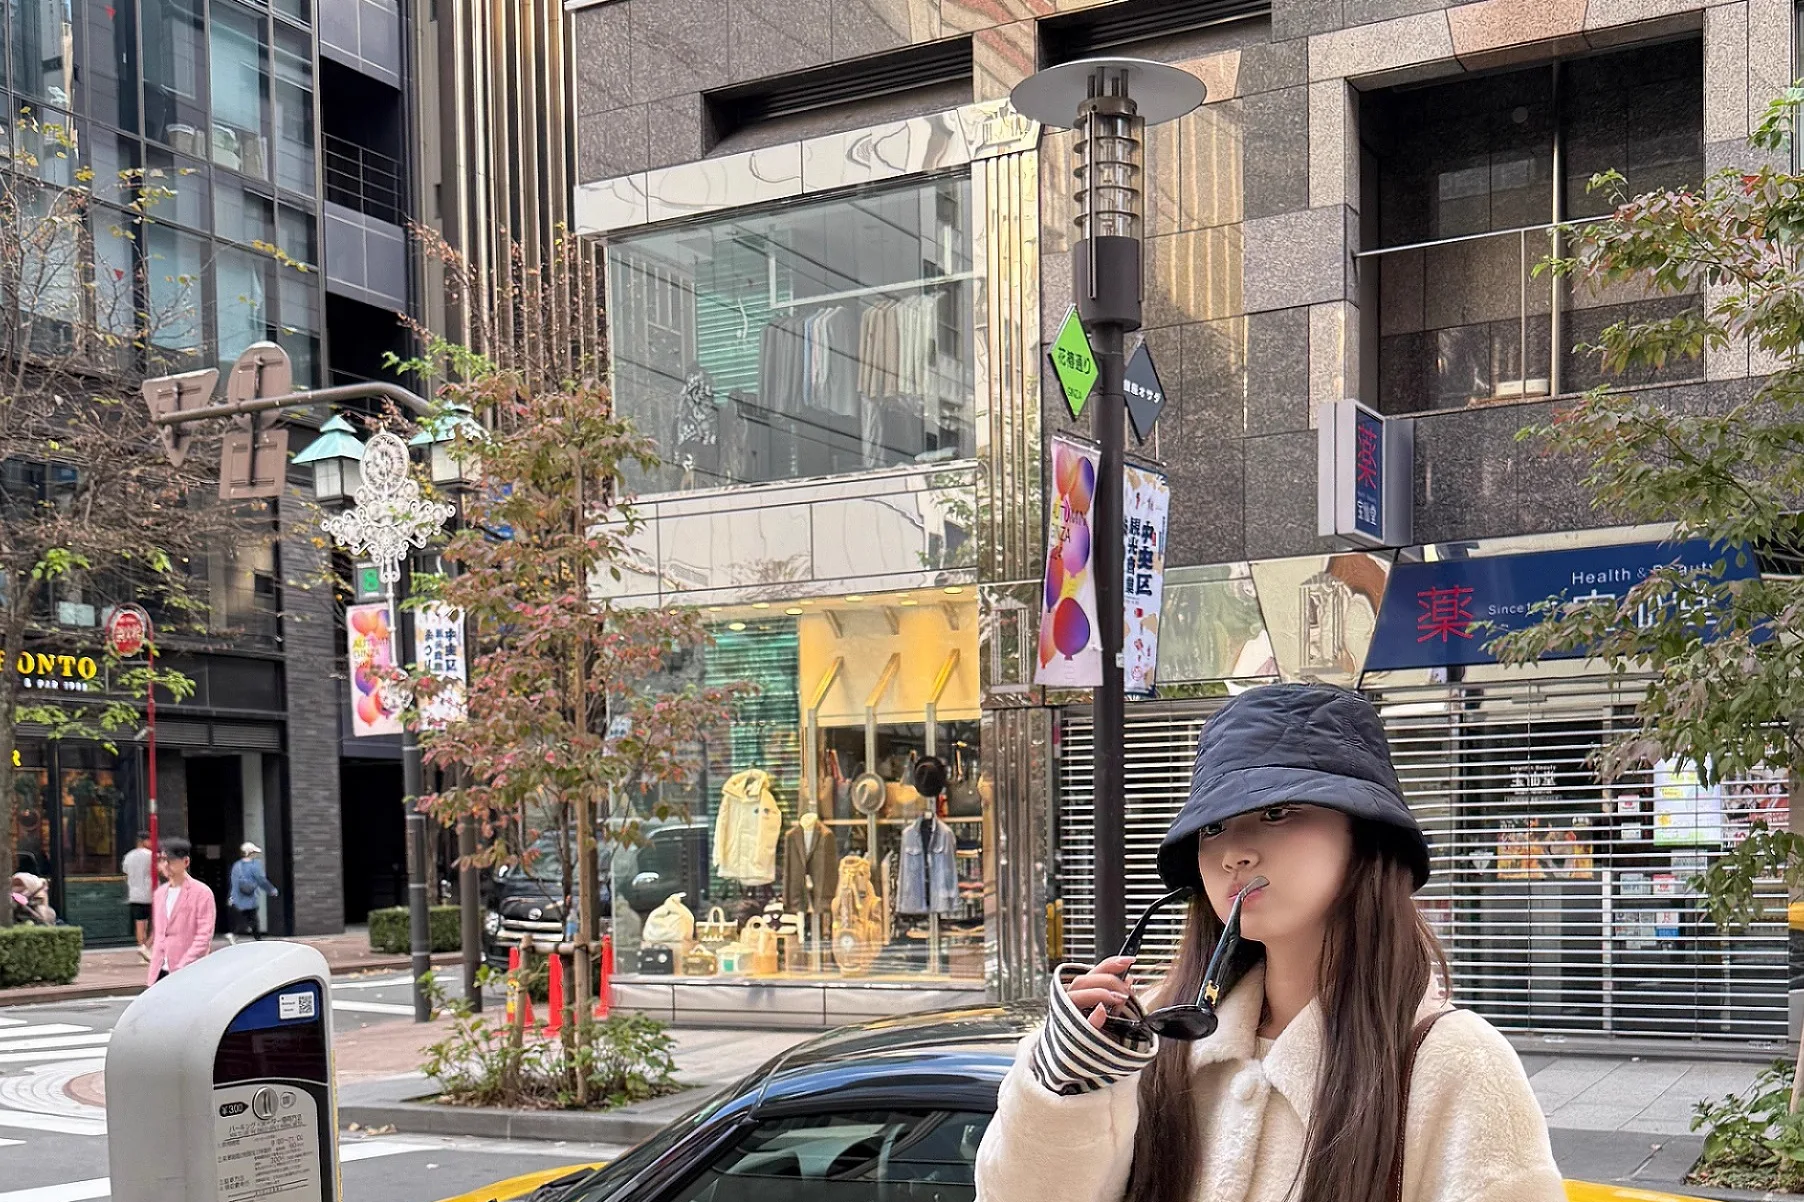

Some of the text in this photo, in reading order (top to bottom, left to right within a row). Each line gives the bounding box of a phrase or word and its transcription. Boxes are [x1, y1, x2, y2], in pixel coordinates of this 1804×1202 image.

[1357, 423, 1377, 490] 薬
[1135, 521, 1154, 596] 中央区
[1572, 567, 1632, 586] Health
[1637, 566, 1648, 580] &
[1416, 584, 1475, 644] 薬
[1488, 603, 1525, 616] Since
